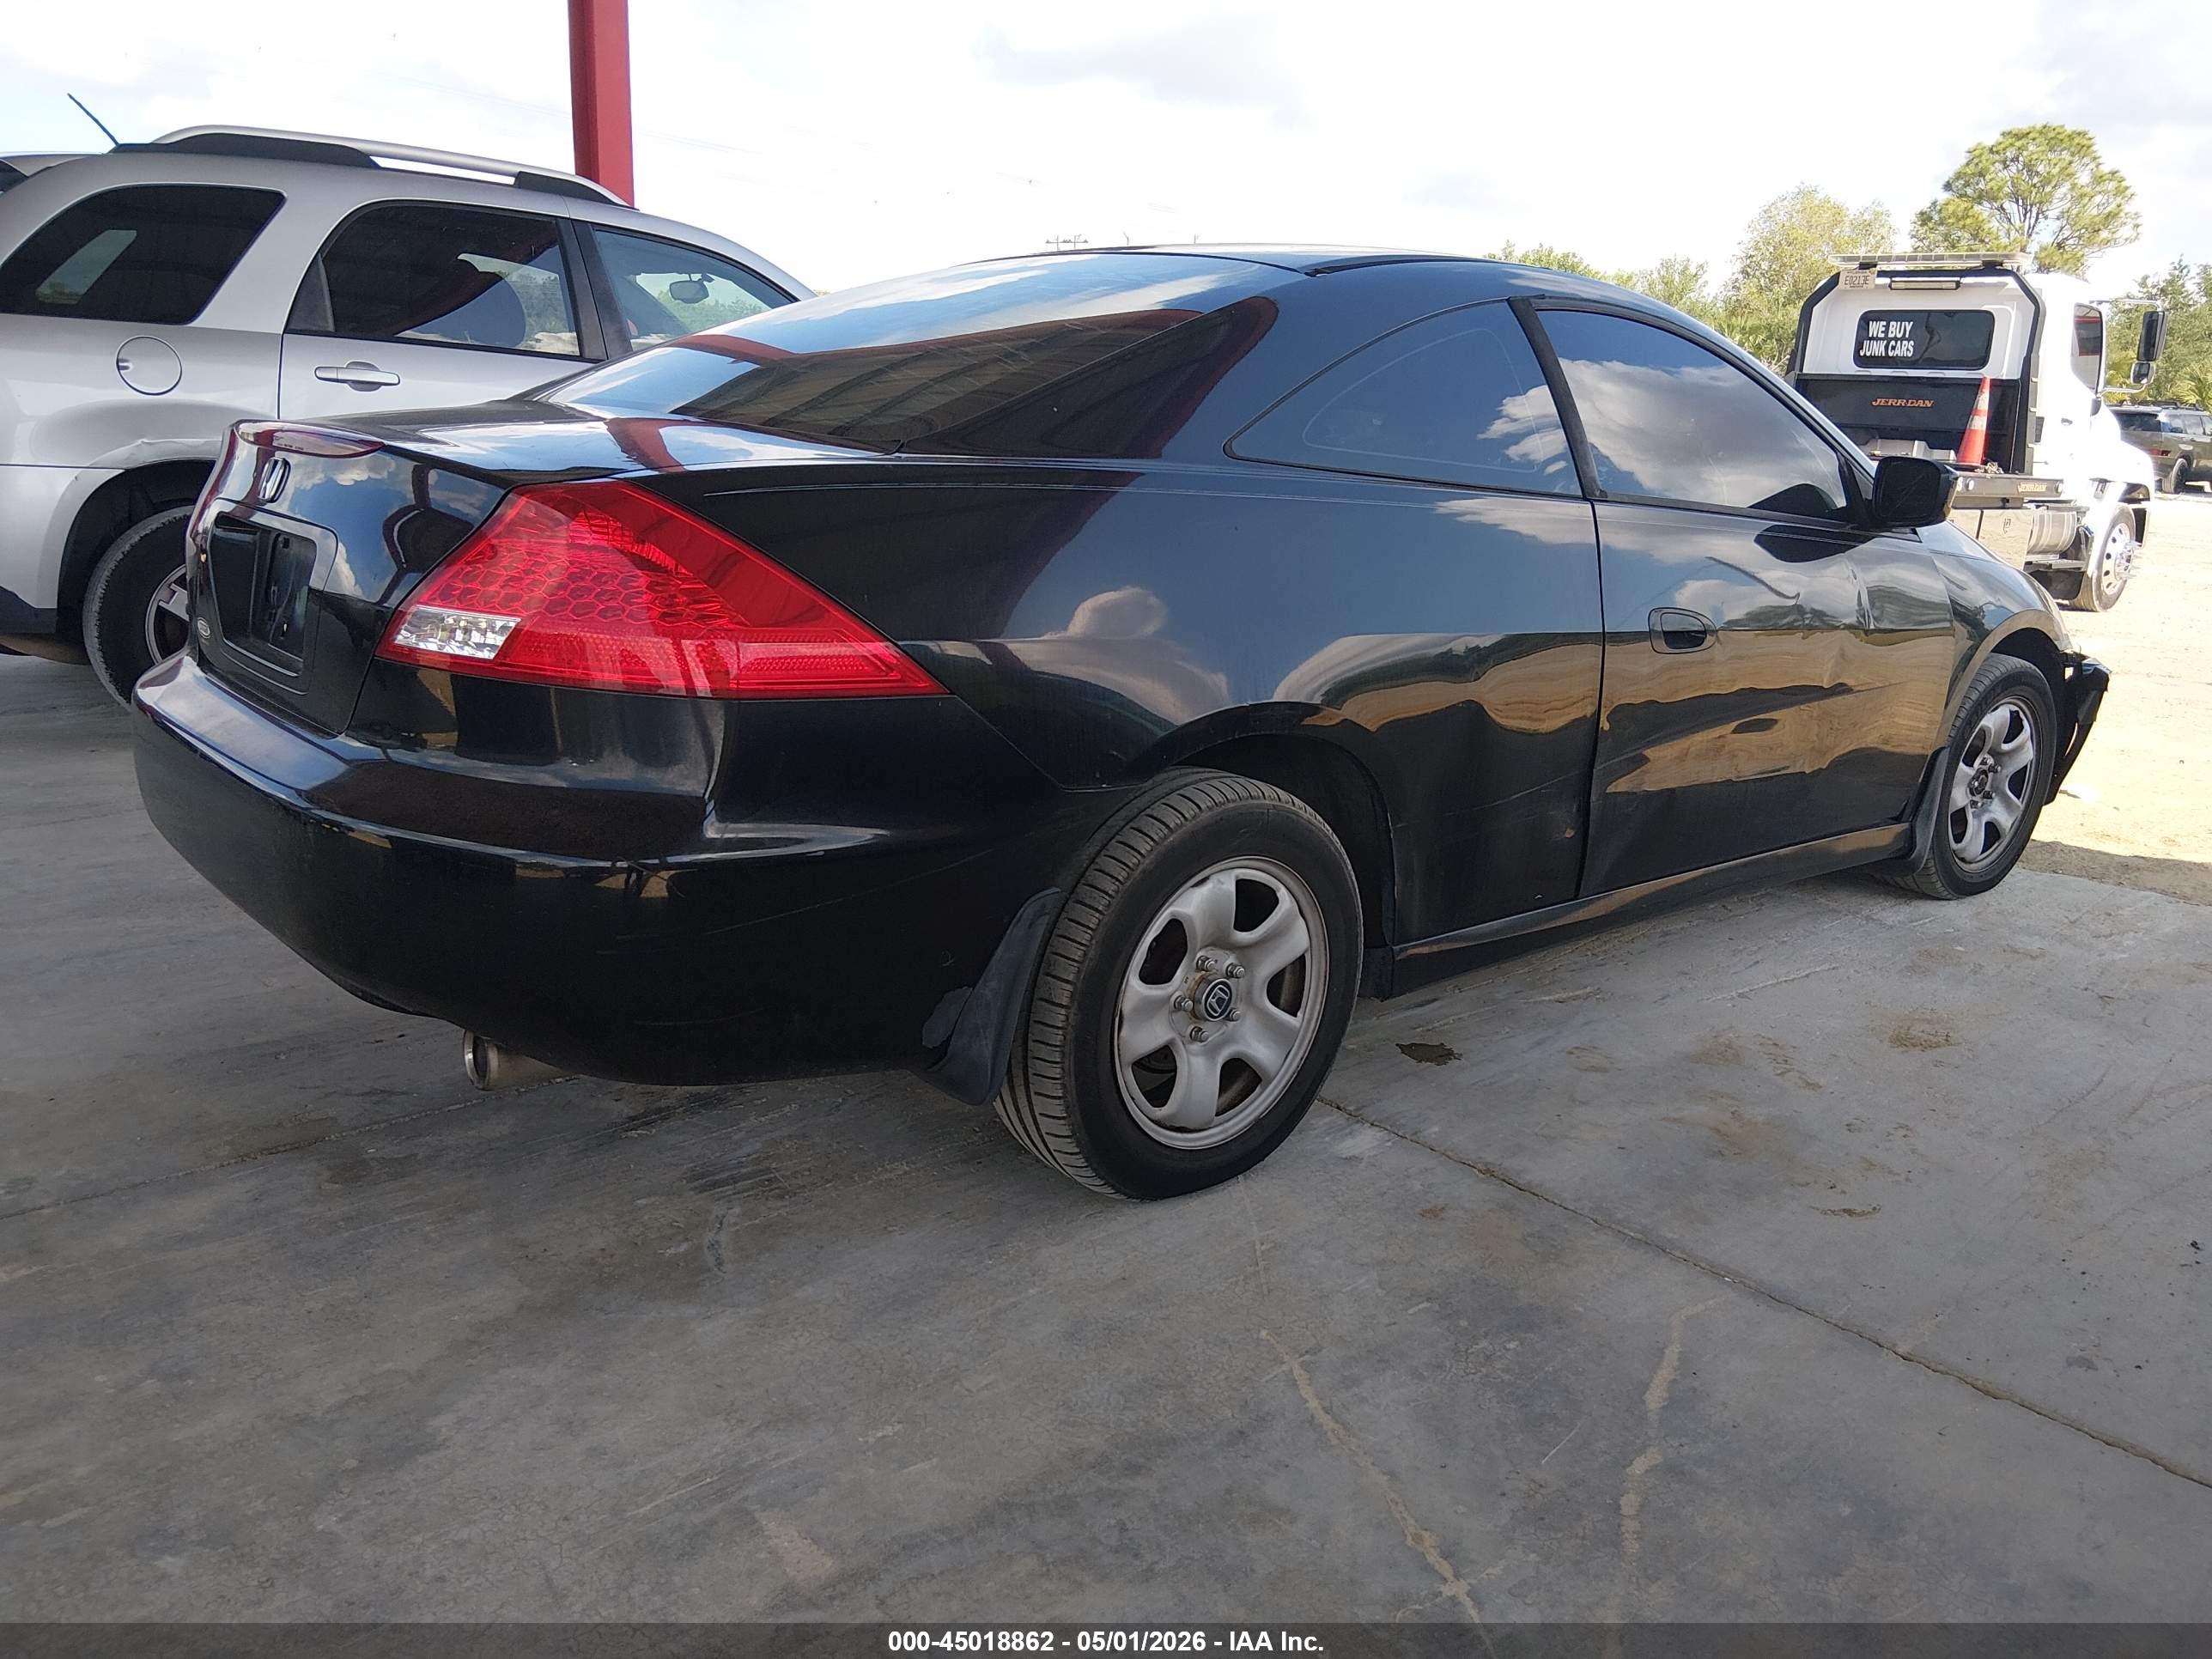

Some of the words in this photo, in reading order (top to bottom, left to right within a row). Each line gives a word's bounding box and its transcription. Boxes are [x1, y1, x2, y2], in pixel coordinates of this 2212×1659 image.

[1869, 320, 1887, 337] WE
[1887, 321, 1913, 338] BUY
[1859, 340, 1887, 356] JUNK
[1887, 340, 1915, 357] CARS
